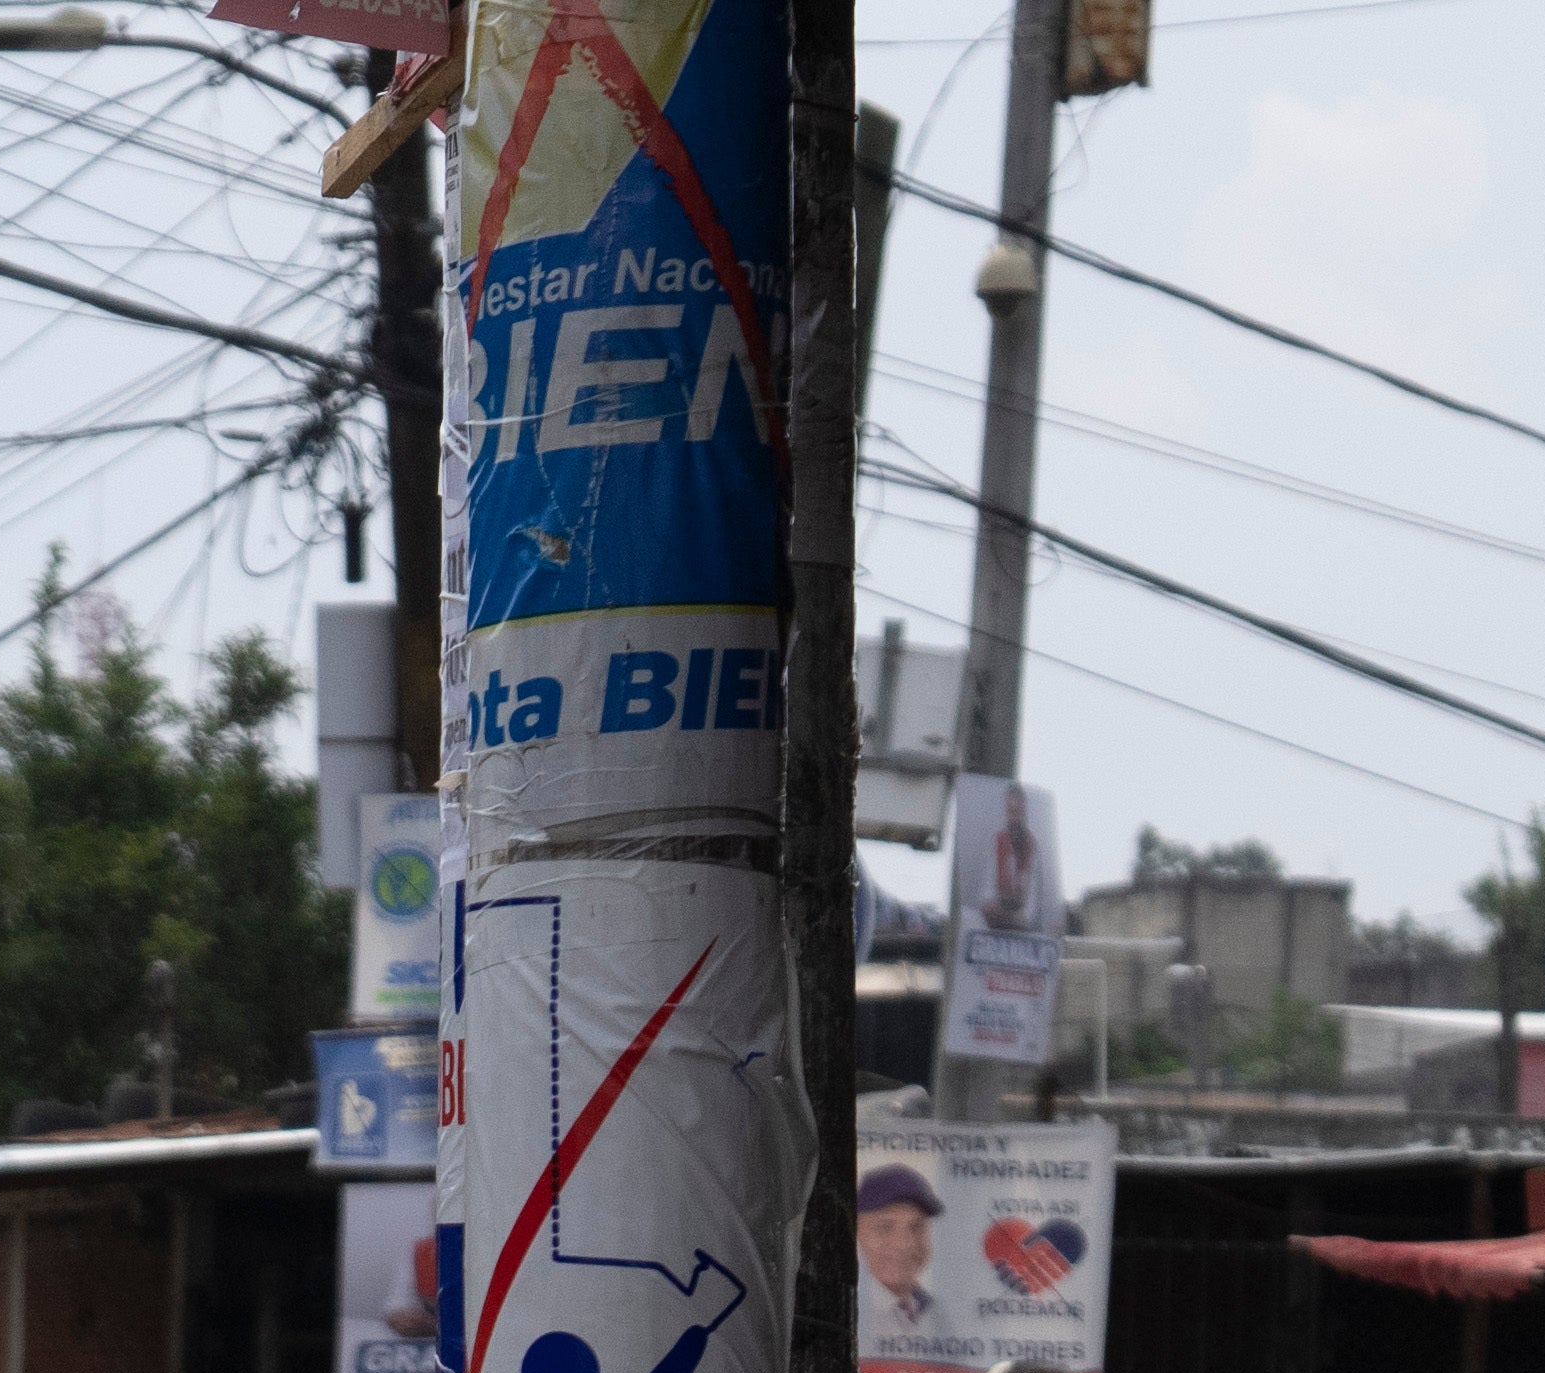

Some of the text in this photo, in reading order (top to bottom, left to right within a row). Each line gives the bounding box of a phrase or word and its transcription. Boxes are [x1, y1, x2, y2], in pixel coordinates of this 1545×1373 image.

[952, 1157, 1090, 1181] HONRADEZ
[878, 1333, 1087, 1361] HORACIO TORRES
